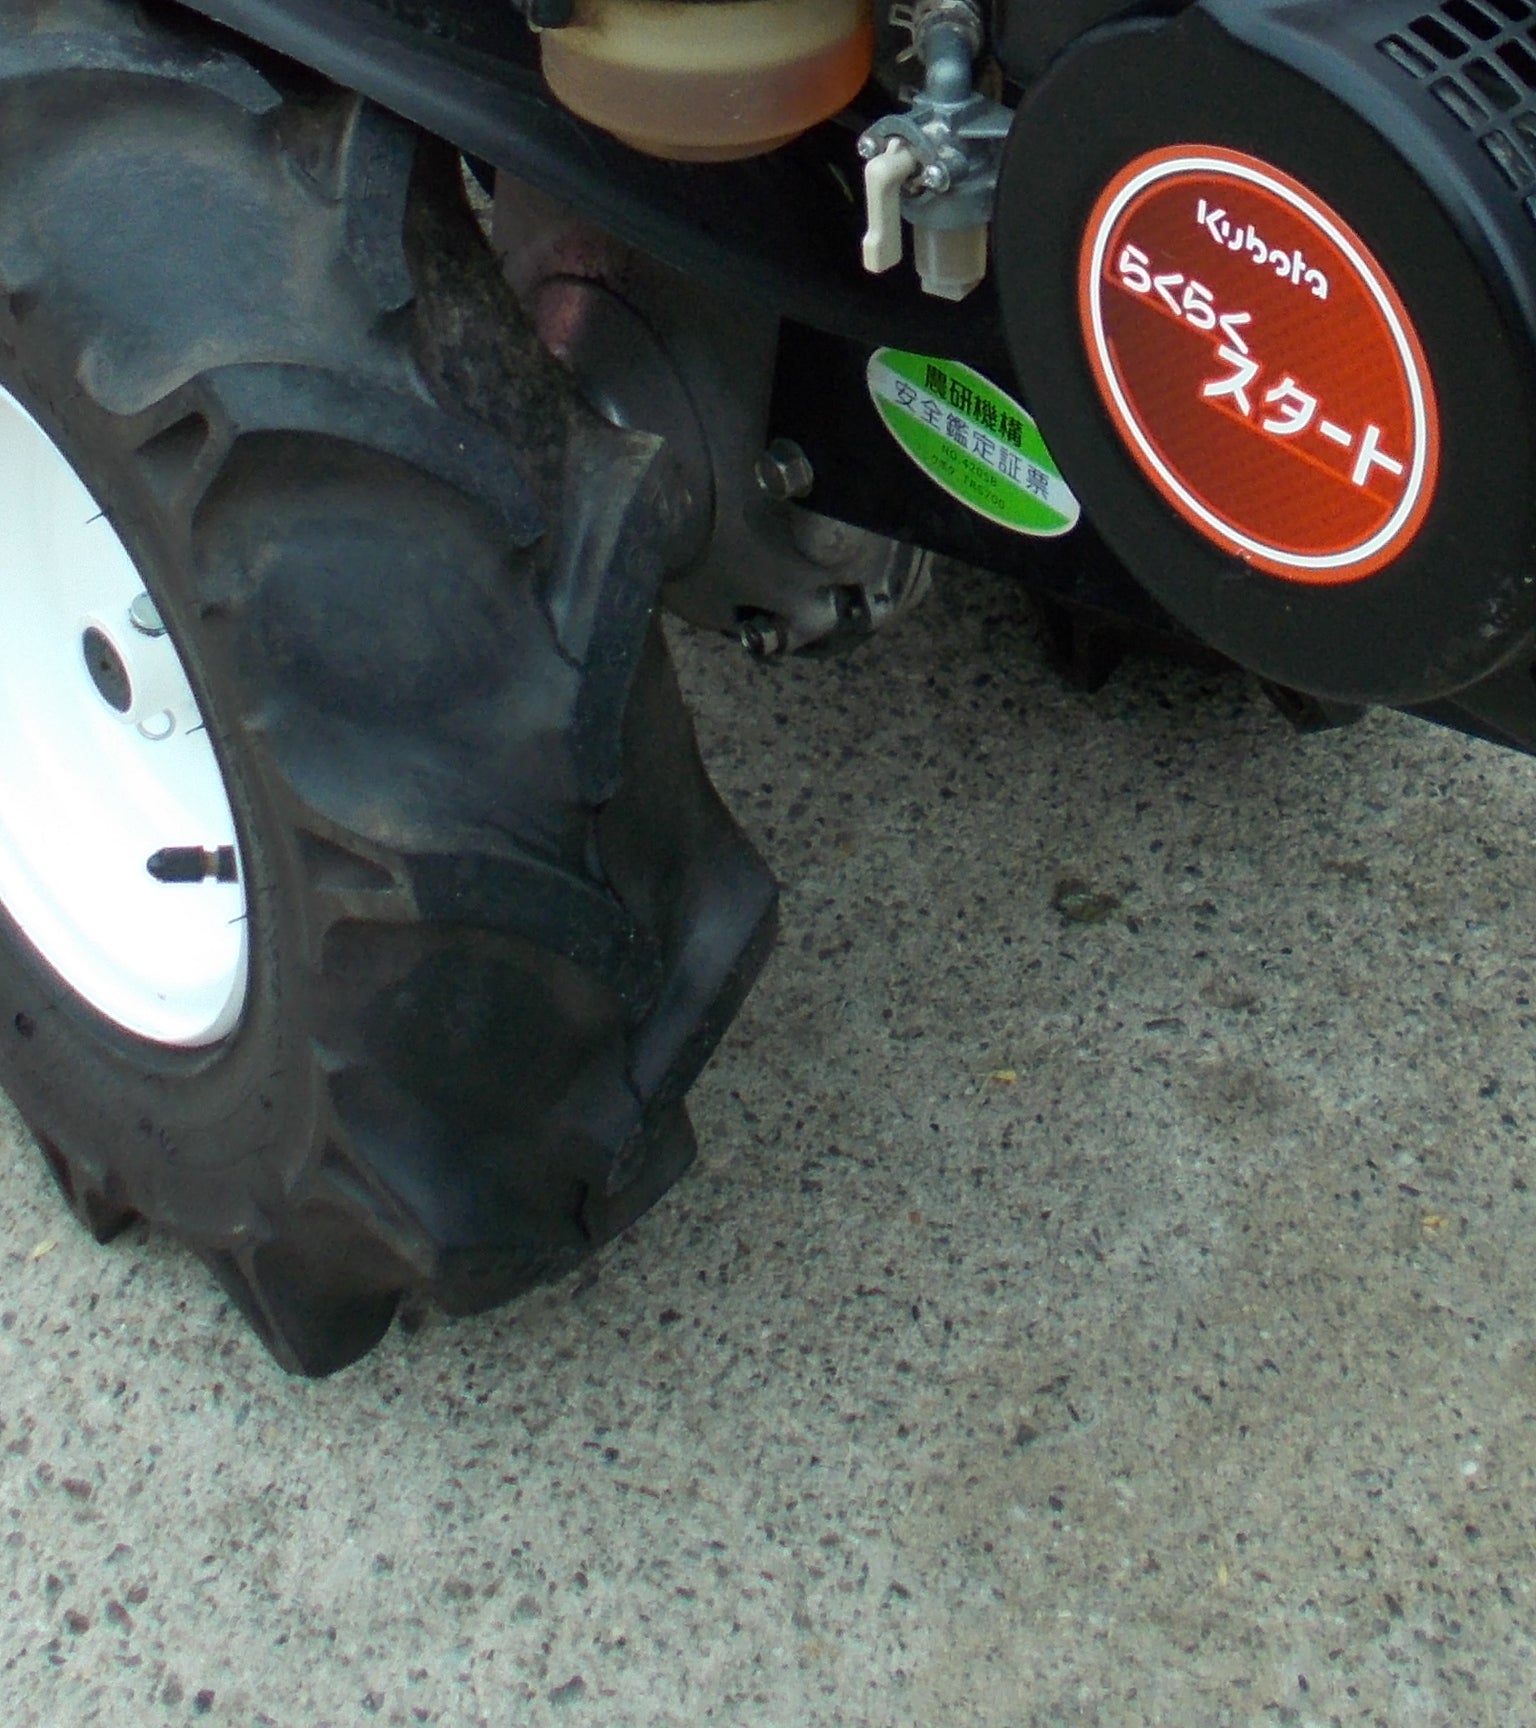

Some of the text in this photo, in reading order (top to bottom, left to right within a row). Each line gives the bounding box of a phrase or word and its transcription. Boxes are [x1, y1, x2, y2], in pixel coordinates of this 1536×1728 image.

[1118, 244, 1251, 354] らくらく
[1197, 198, 1328, 300] Kubota
[895, 379, 1050, 500] 安全鑑定証票
[924, 363, 1023, 448] 農研機構
[1203, 344, 1404, 486] スタート
